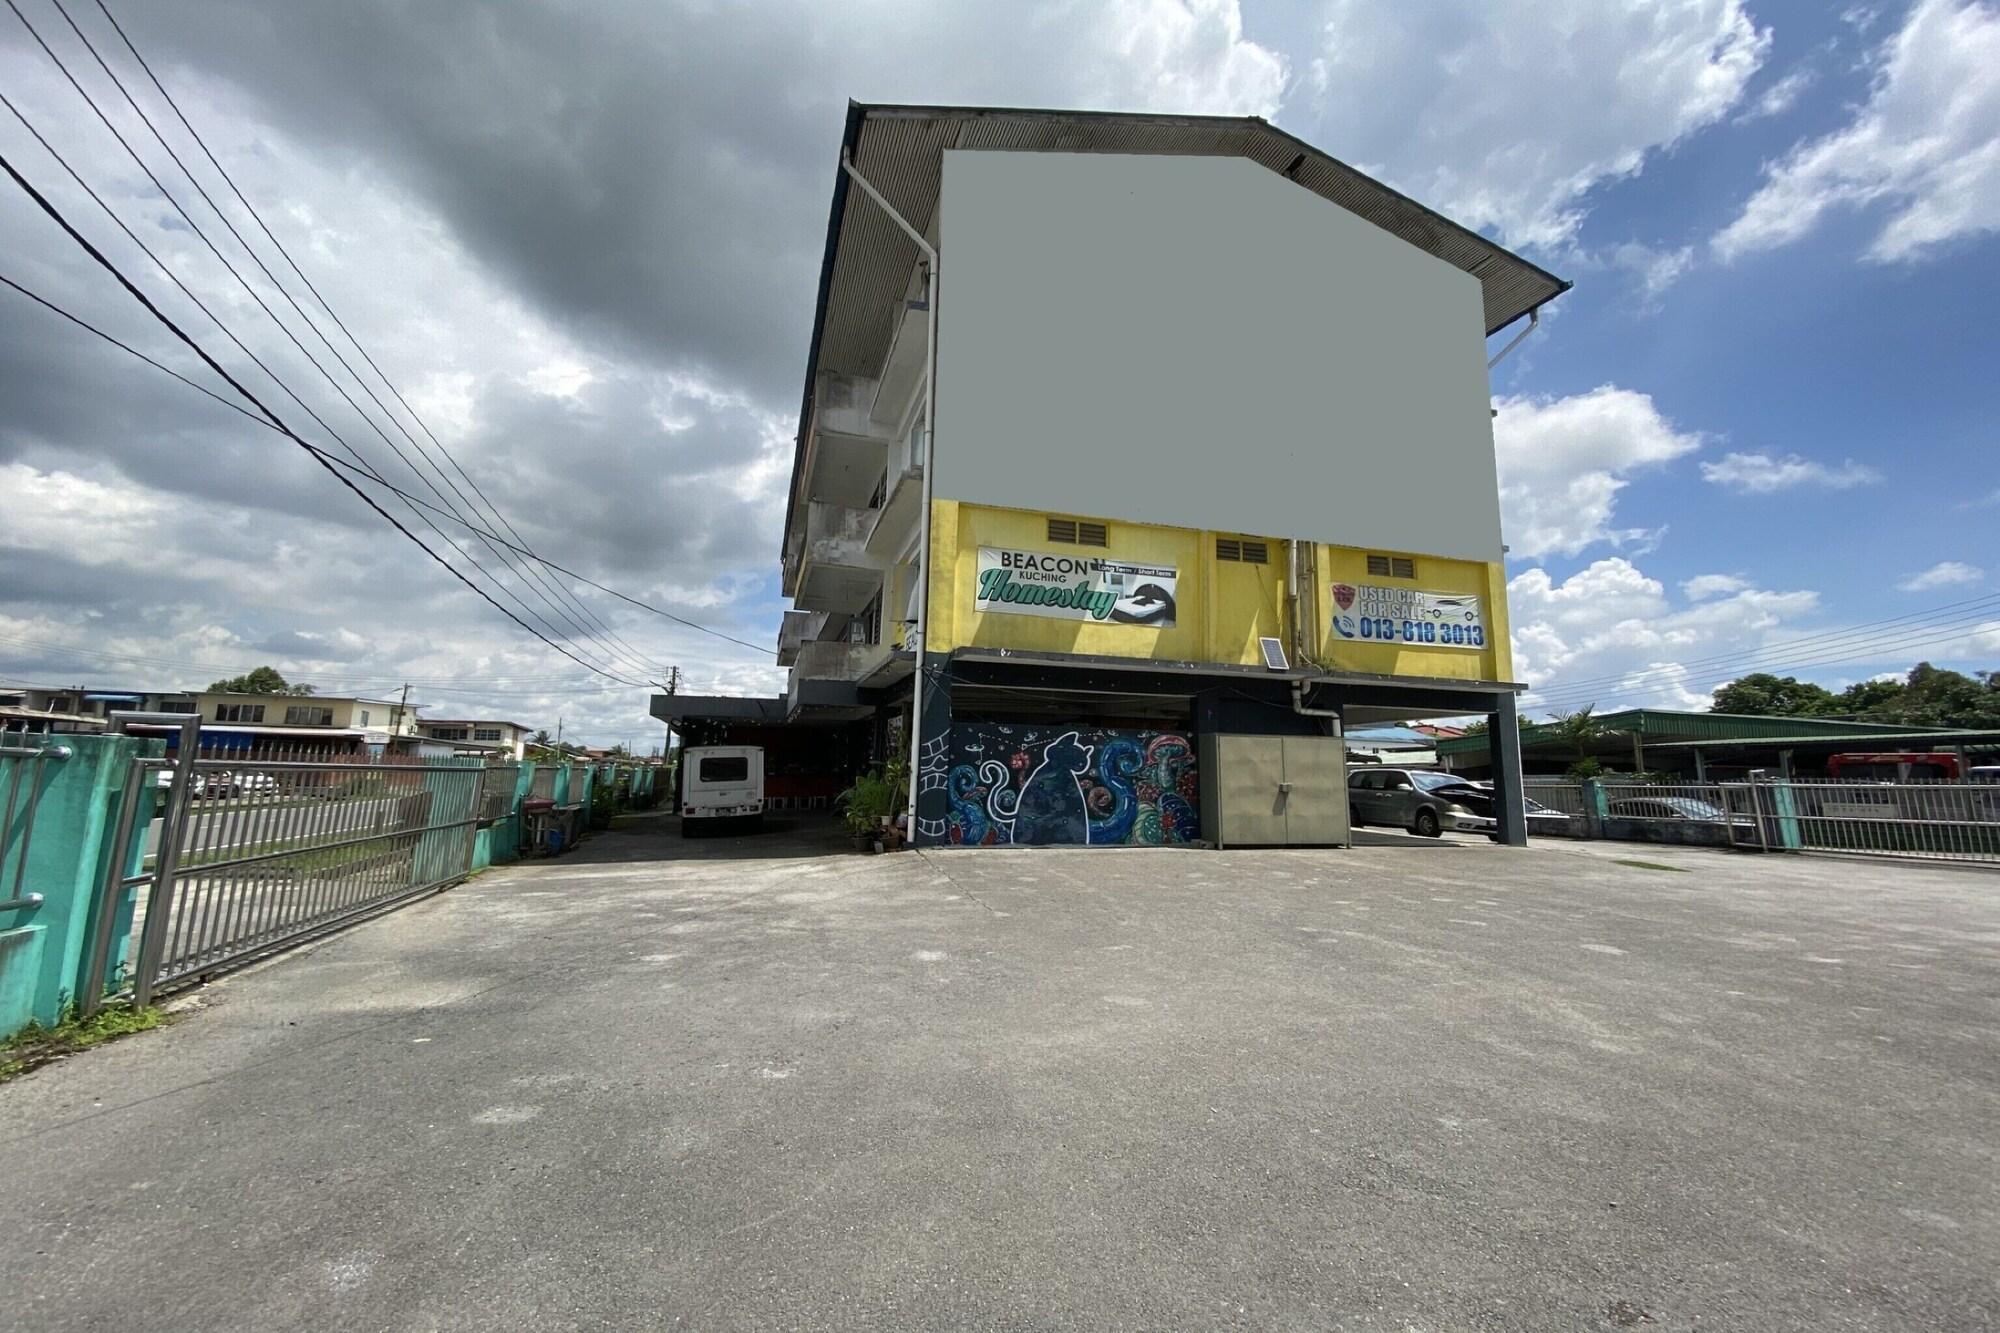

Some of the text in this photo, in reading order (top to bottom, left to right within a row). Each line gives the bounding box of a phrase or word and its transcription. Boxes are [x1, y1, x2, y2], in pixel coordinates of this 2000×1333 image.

[1001, 551, 1087, 575] BEACON
[1019, 570, 1067, 584] KUCHING
[978, 569, 1117, 619] Homestay
[1359, 585, 1394, 603] USED
[1396, 589, 1425, 604] CAR
[1359, 601, 1426, 620] FOR SALE
[1440, 624, 1484, 645] 3013
